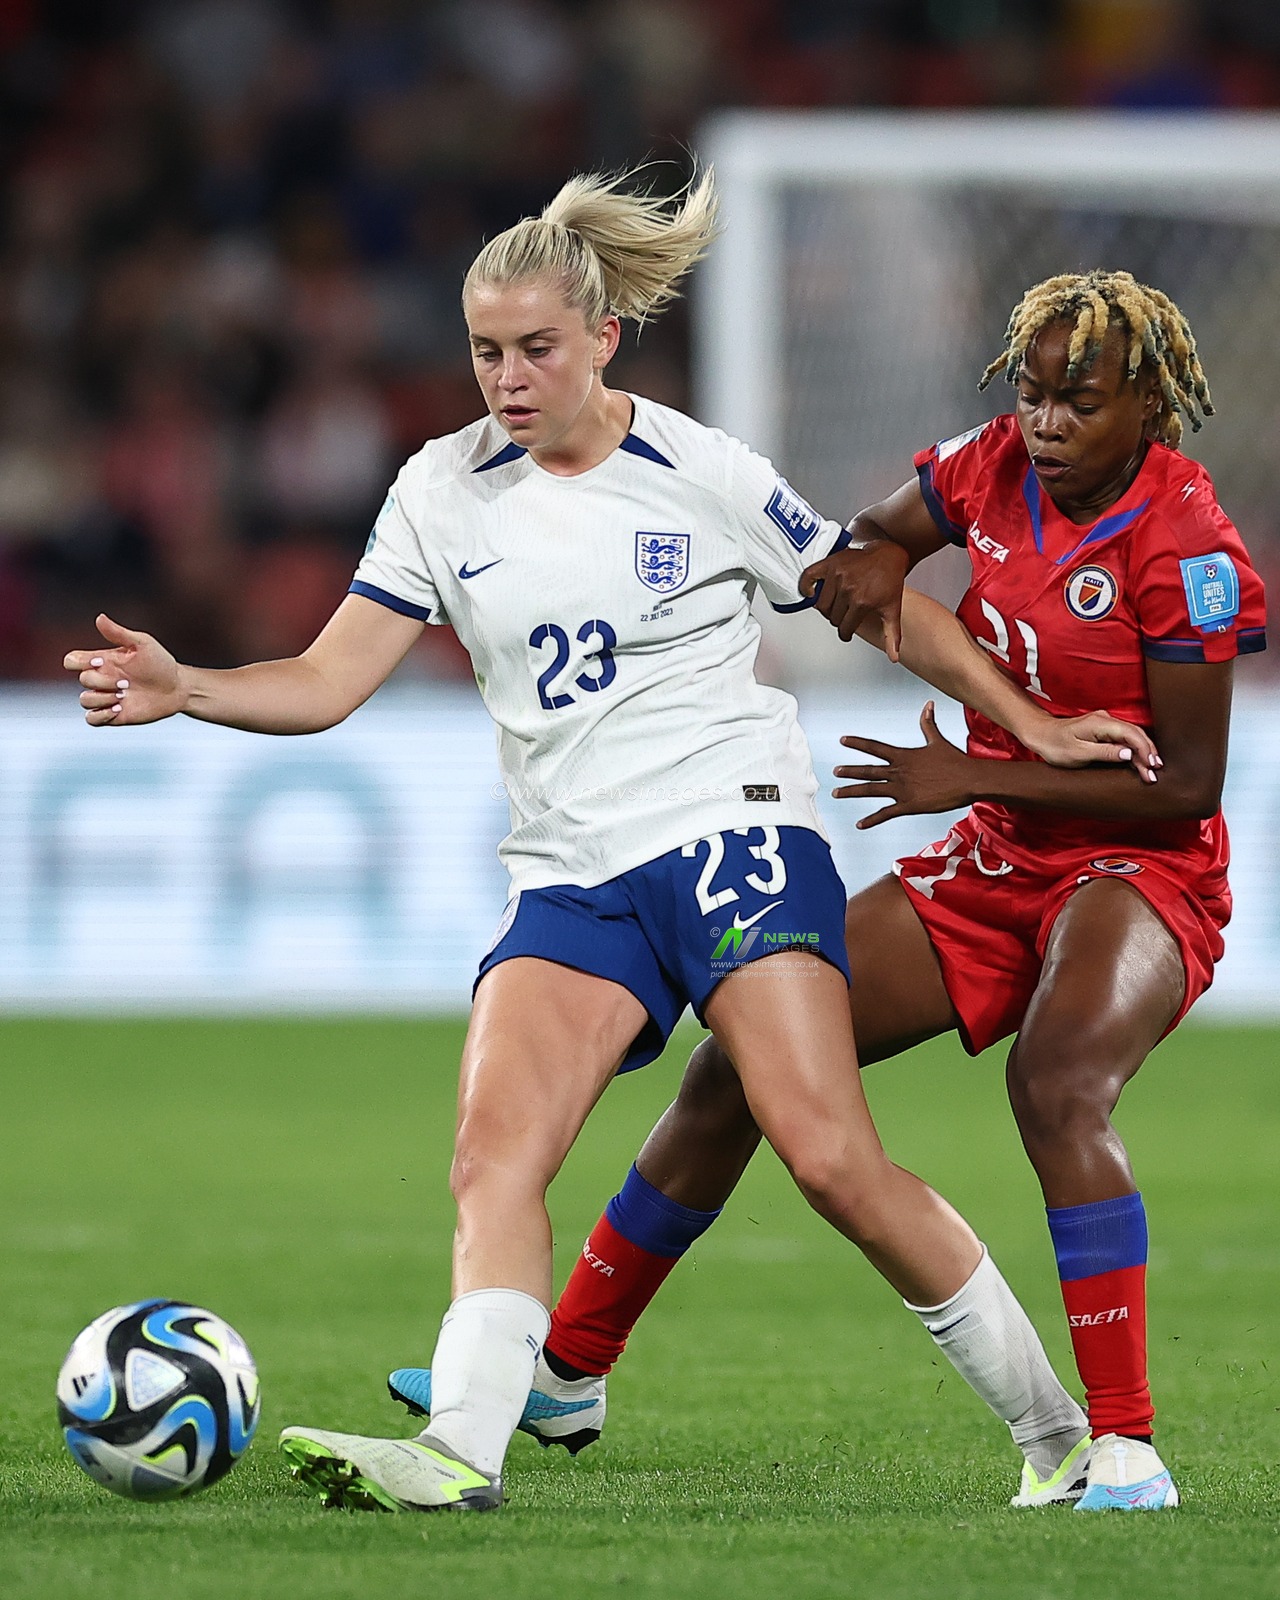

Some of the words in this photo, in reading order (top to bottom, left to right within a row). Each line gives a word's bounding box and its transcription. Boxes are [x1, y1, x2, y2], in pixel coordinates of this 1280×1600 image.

[1203, 587, 1225, 598] UNITES
[640, 614, 649, 622] 22
[529, 619, 617, 710] 23
[681, 825, 788, 917] 23
[1069, 1306, 1128, 1327] SAETA
